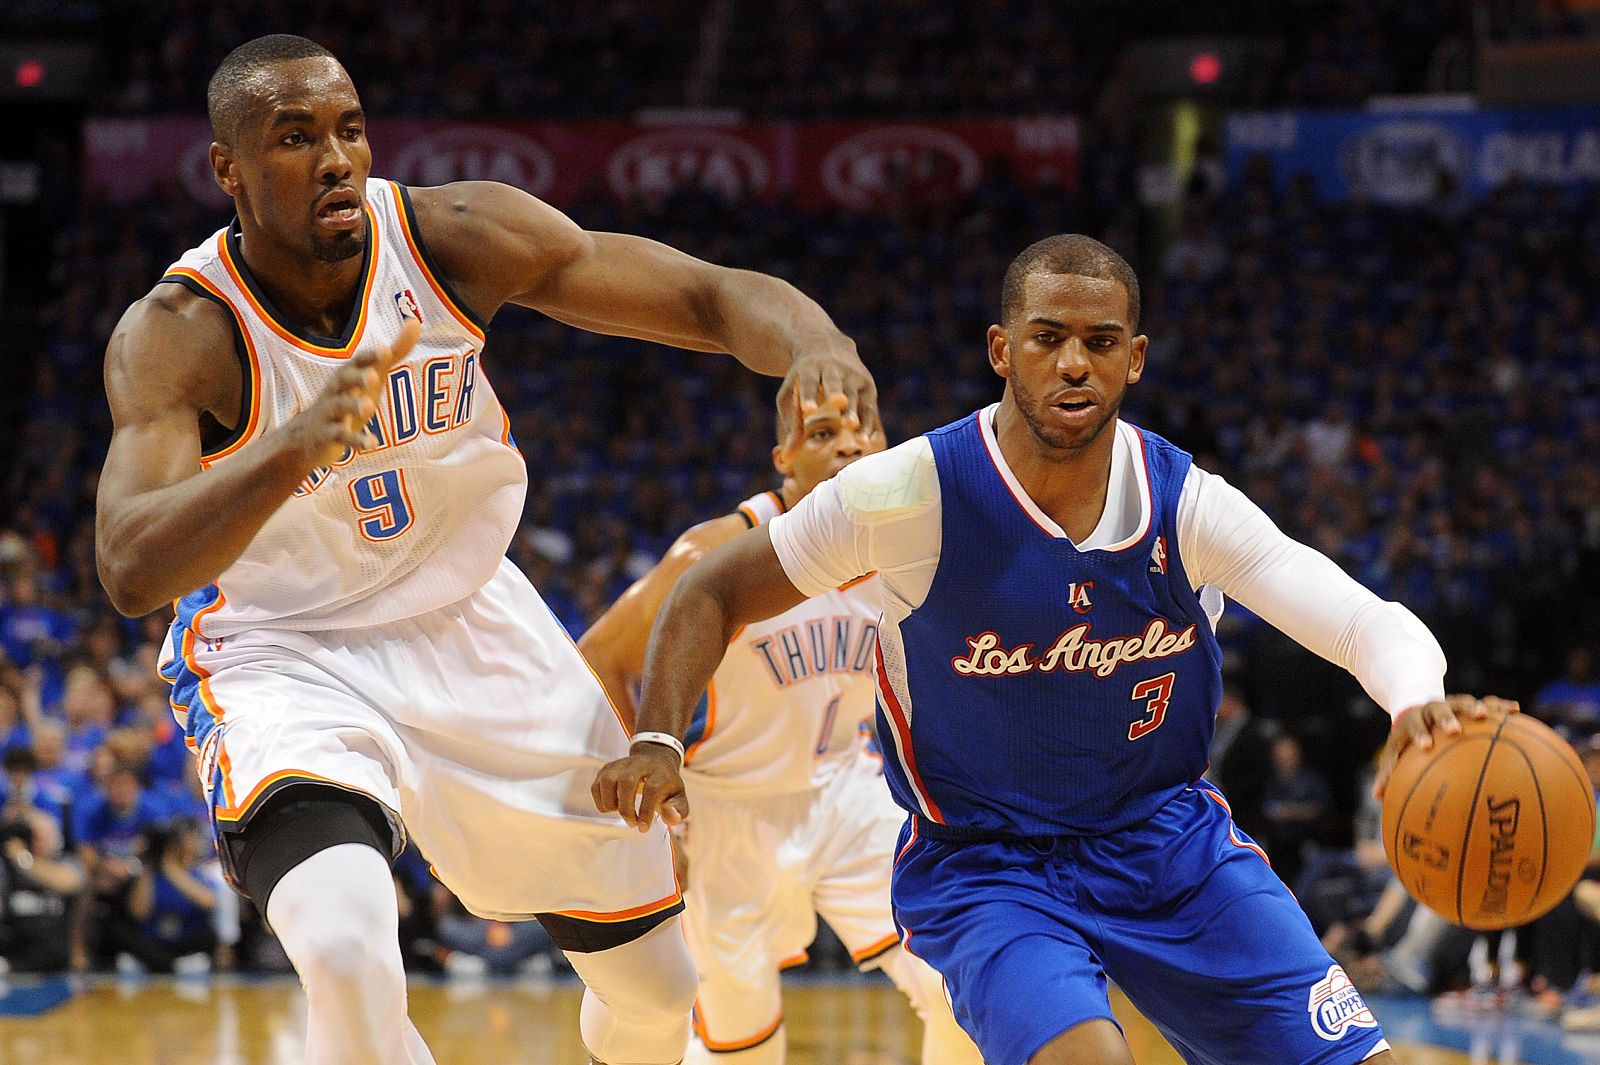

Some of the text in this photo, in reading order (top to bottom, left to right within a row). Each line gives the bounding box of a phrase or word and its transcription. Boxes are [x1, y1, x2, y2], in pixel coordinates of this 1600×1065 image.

[347, 468, 415, 542] 9
[750, 615, 877, 690] THUND
[952, 617, 1197, 679] Los Angeles
[1128, 671, 1176, 741] 3
